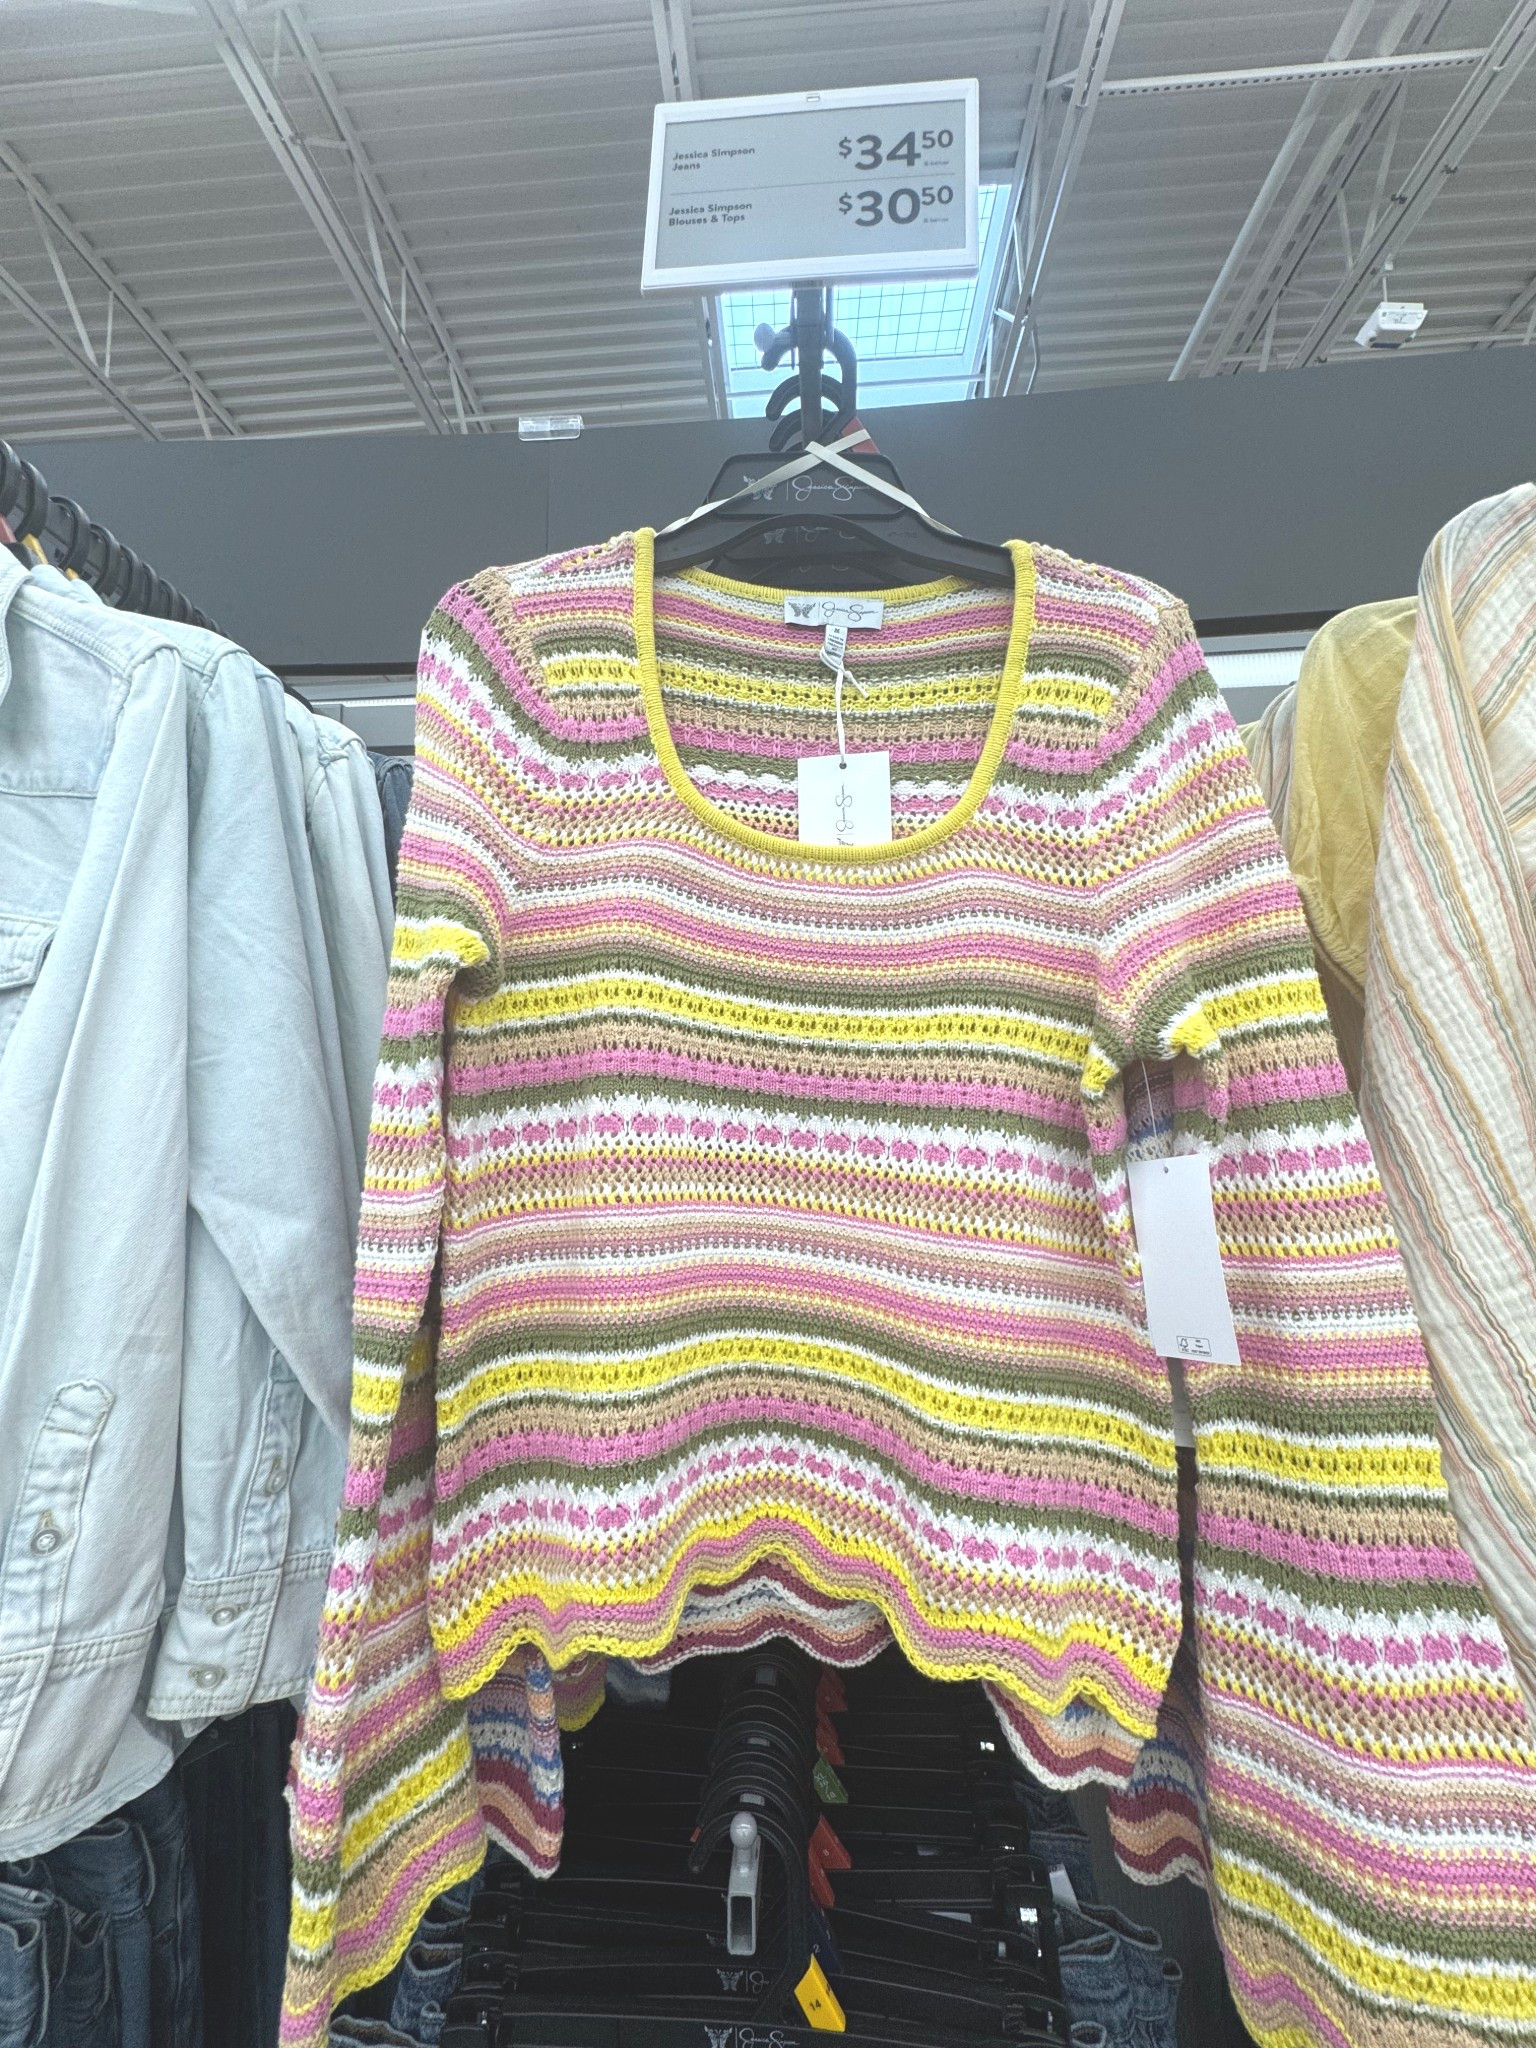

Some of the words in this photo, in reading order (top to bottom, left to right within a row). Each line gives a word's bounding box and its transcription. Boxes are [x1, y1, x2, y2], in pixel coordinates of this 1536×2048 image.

[672, 150, 709, 161] Jessica
[711, 147, 756, 158] Simpson
[672, 162, 701, 172] Jeans
[668, 205, 705, 216] Jessica
[707, 203, 753, 214] Simpson
[668, 216, 708, 227] Blouses
[710, 214, 719, 223] &
[721, 213, 746, 224] Tops
[809, 1999, 822, 2012] 14
